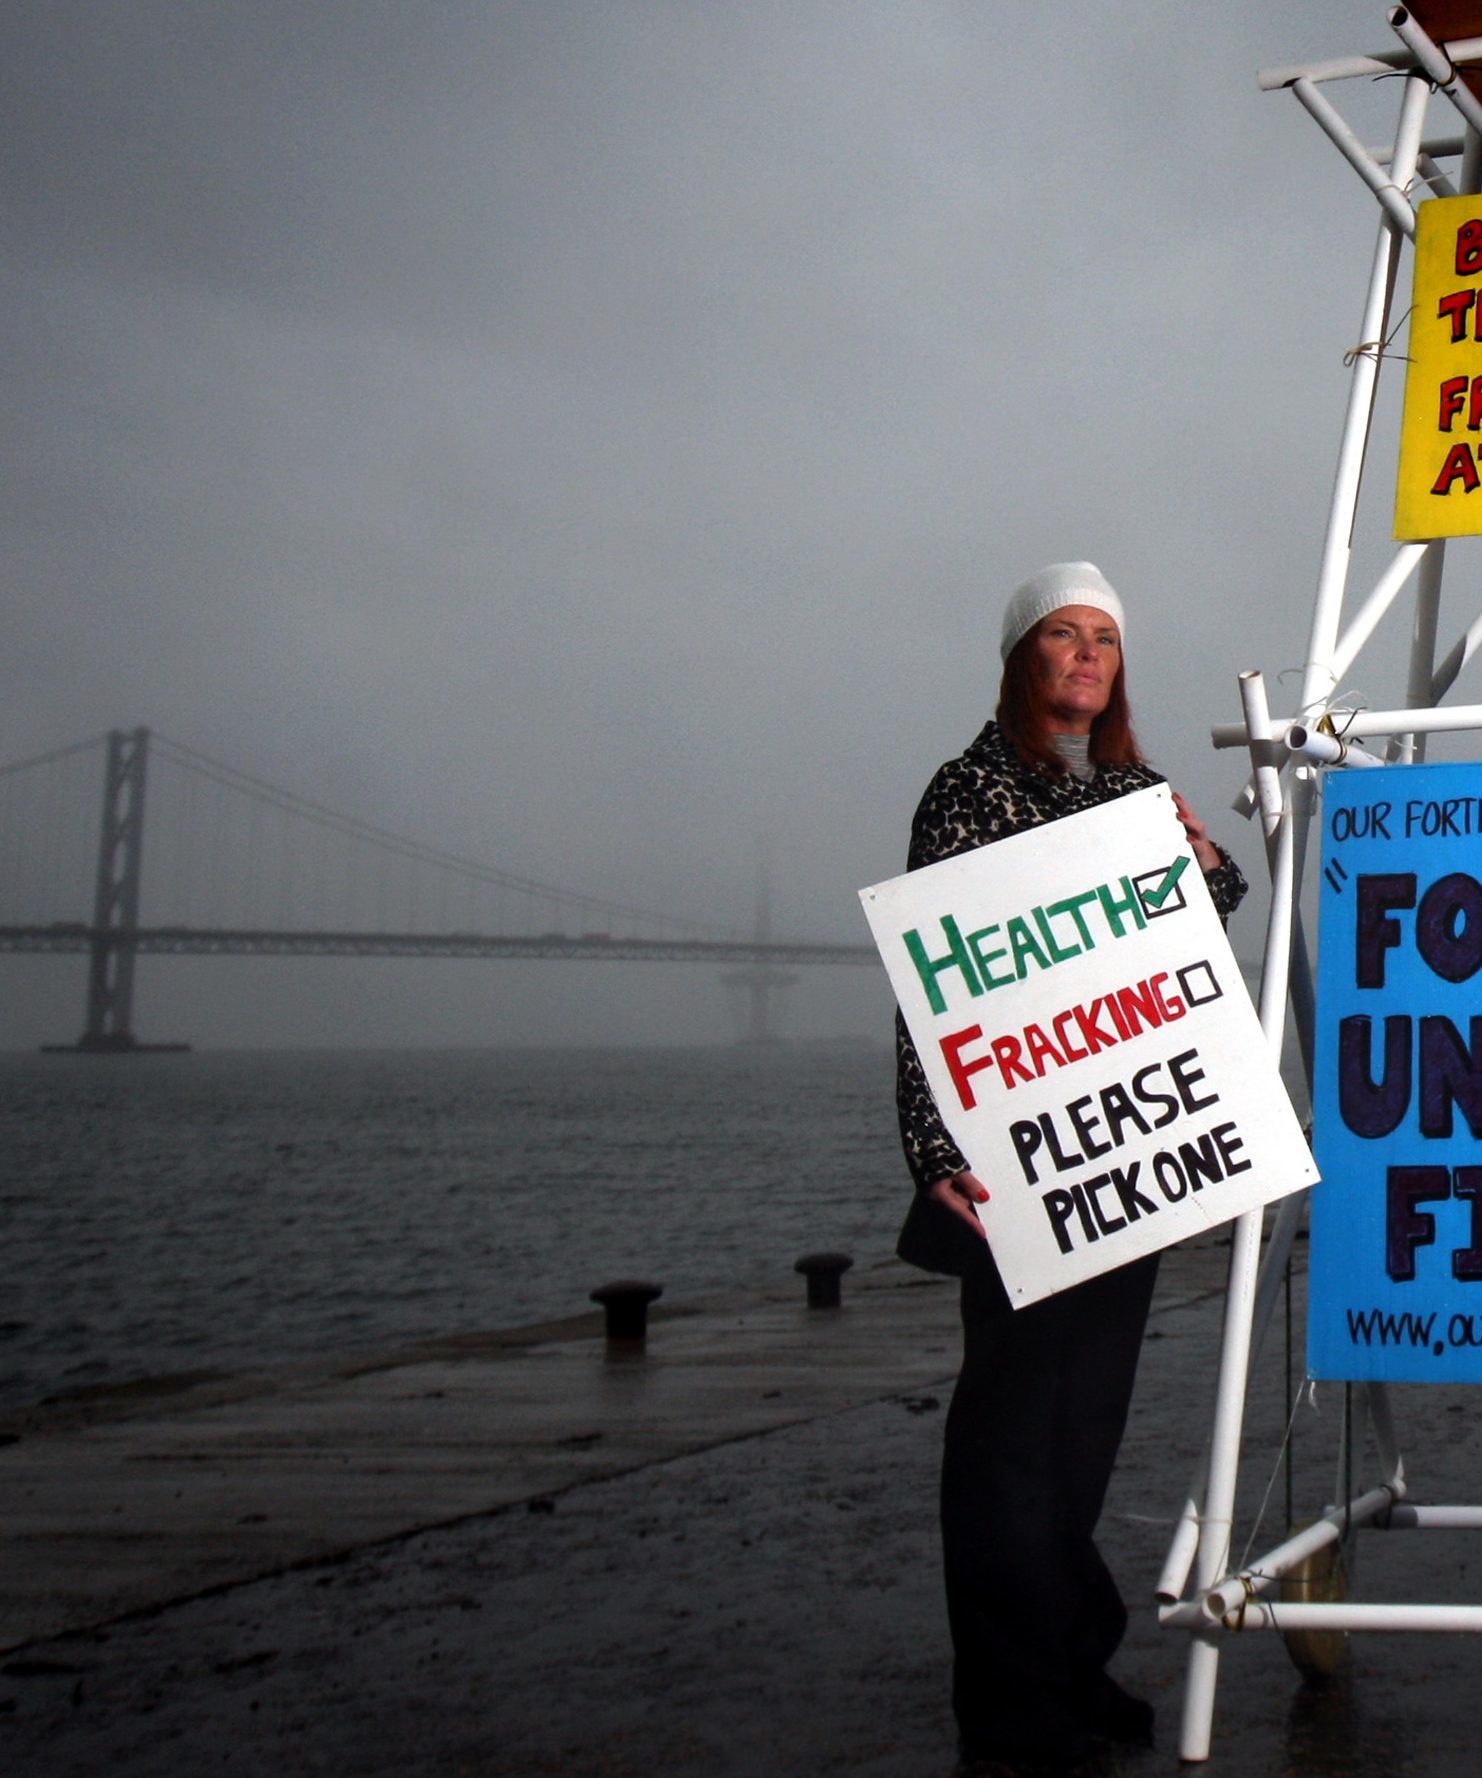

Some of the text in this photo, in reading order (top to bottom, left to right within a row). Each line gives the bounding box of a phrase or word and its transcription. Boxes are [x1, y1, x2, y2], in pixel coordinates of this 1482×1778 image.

[1331, 801, 1391, 842] OUR
[902, 876, 1147, 1015] HEALTH
[939, 972, 1186, 1111] FRACKING
[1009, 1048, 1220, 1186] PLEASE
[1042, 1121, 1252, 1254] PICK ONE
